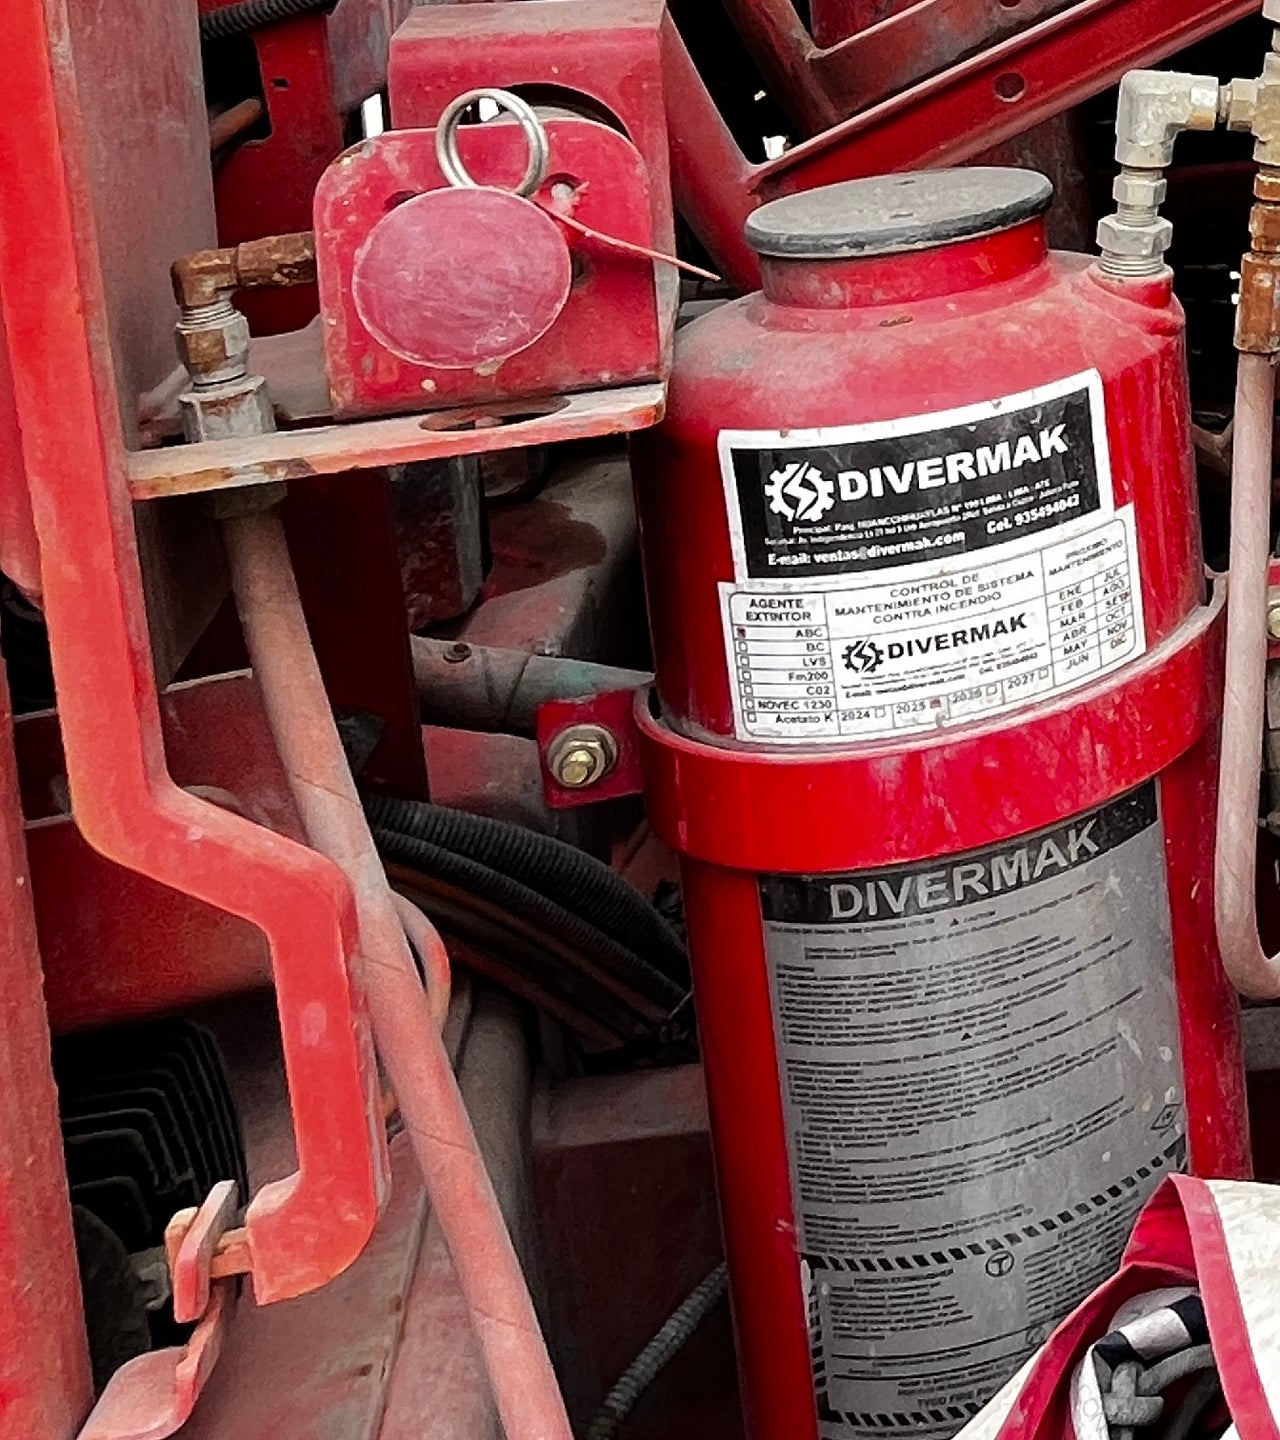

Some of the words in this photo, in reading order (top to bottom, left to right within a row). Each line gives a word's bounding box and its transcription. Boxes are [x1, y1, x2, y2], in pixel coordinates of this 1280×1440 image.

[837, 423, 1070, 503] DIVERMAK
[768, 552, 811, 565] E-mail:
[813, 531, 966, 564] ventas@divermak.com
[835, 591, 950, 617] MANTENIMIENTO
[954, 586, 972, 597] DE
[977, 570, 1035, 593] SISTEMA
[890, 579, 959, 599] CONTROL
[963, 572, 979, 583] DE
[749, 598, 805, 610] AGENTE
[873, 607, 931, 624] CONTRA
[936, 591, 1001, 614] INCENDIO
[746, 611, 811, 622] EXTINTOR
[1060, 612, 1086, 627] MAR
[795, 628, 823, 639] ABC
[887, 612, 1029, 659] DIVERMAK
[1063, 639, 1088, 655] MAY
[1066, 653, 1090, 670] JUN
[1008, 674, 1035, 690] 2027
[829, 820, 1100, 920] DIVERMAK
